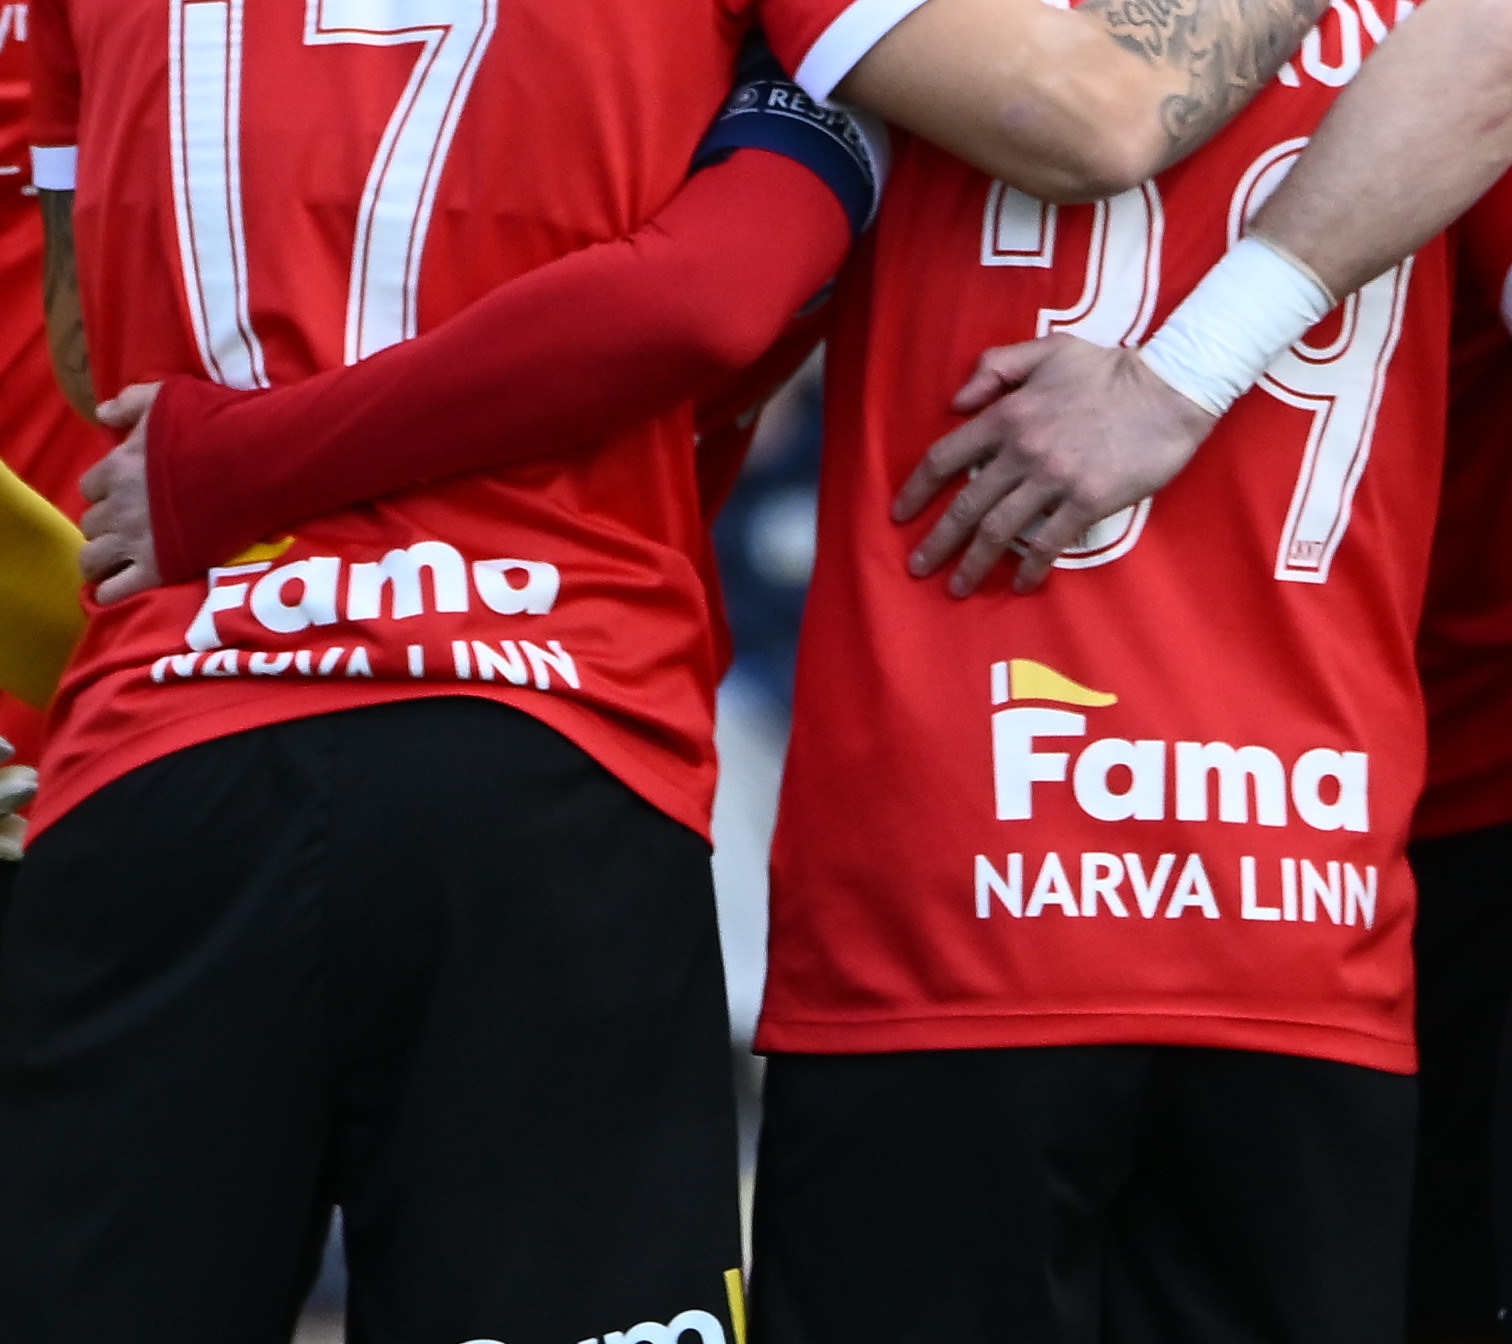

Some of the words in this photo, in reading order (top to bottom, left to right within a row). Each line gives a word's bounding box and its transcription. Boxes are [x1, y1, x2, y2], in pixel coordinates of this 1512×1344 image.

[184, 540, 561, 653] Fama
[992, 707, 1370, 833] Fama
[974, 852, 1221, 922] NARVA
[1239, 855, 1379, 930] LINN
